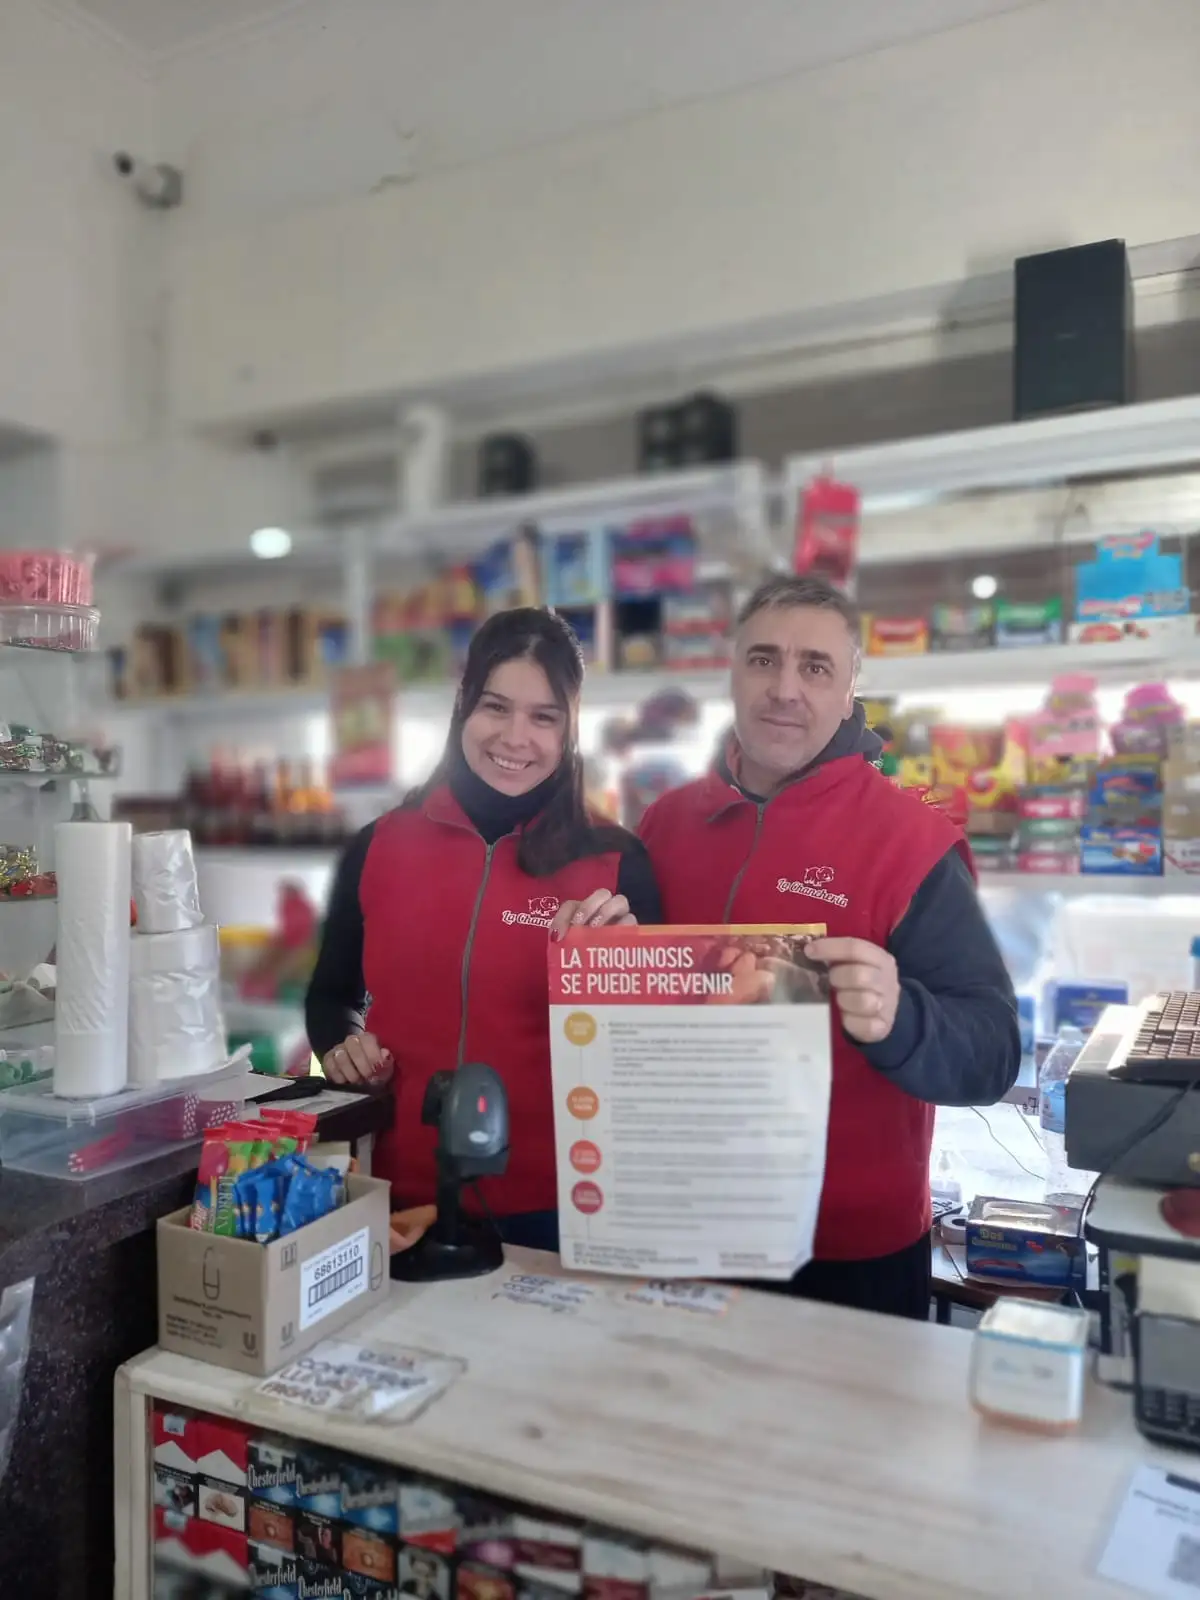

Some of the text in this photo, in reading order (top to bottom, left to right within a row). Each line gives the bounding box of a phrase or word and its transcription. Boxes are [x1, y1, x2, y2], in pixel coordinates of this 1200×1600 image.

[777, 878, 789, 892] La
[502, 910, 516, 925] La
[561, 946, 694, 969] LA TRIQUINOSIS
[561, 973, 733, 995] SE PUEDE PREVENIR
[314, 1244, 360, 1281] 68613110
[248, 1463, 296, 1491] Chesterfield
